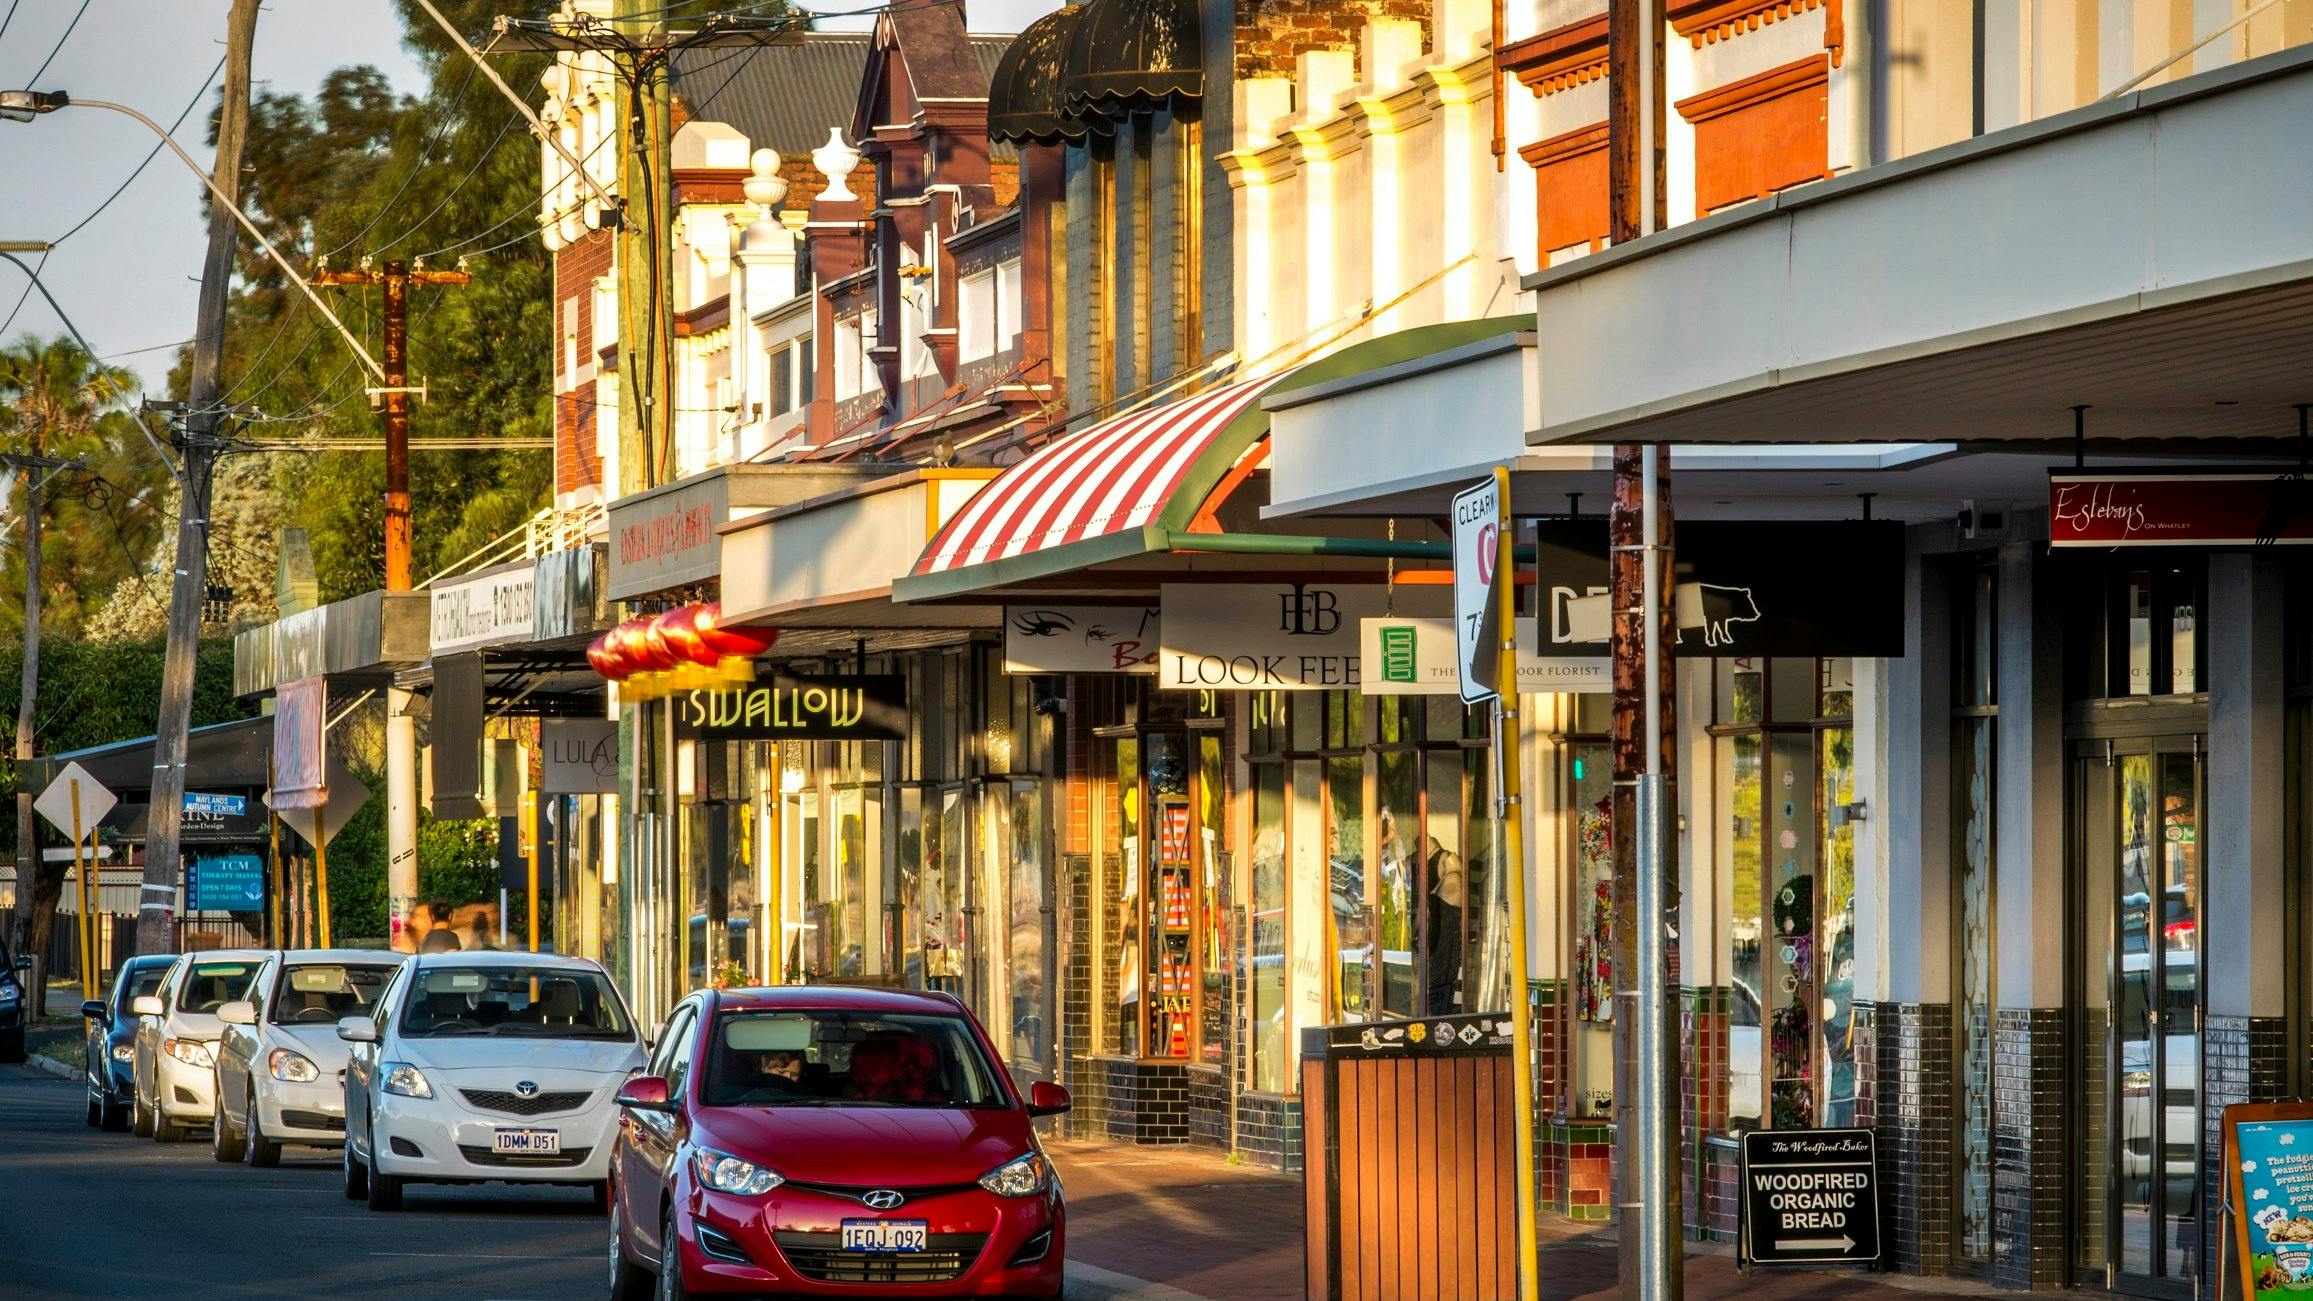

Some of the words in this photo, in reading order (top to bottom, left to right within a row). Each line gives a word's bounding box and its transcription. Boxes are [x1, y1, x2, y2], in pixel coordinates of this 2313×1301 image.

[1177, 655, 1287, 685] LOOK
[1431, 667, 1457, 676] THE
[1548, 667, 1600, 676] FLORIST
[691, 688, 863, 727] SWALLOW
[555, 740, 610, 764] LULA
[185, 802, 211, 812] AUTUMN
[213, 804, 238, 813] CENTRE
[195, 795, 229, 805] MAYLANDS
[220, 861, 249, 870] TCM
[498, 1135, 529, 1149] 1DMM
[1772, 1142, 1789, 1153] The
[1790, 1141, 1839, 1156] Woodfired
[1839, 1139, 1869, 1152] Baker
[2266, 1157, 2285, 1166] The
[1754, 1172, 1868, 1191] WOODFIRED
[1770, 1193, 1856, 1210] ORGANIC
[1782, 1212, 1846, 1229] BREAD
[2263, 1209, 2282, 1226] NEW
